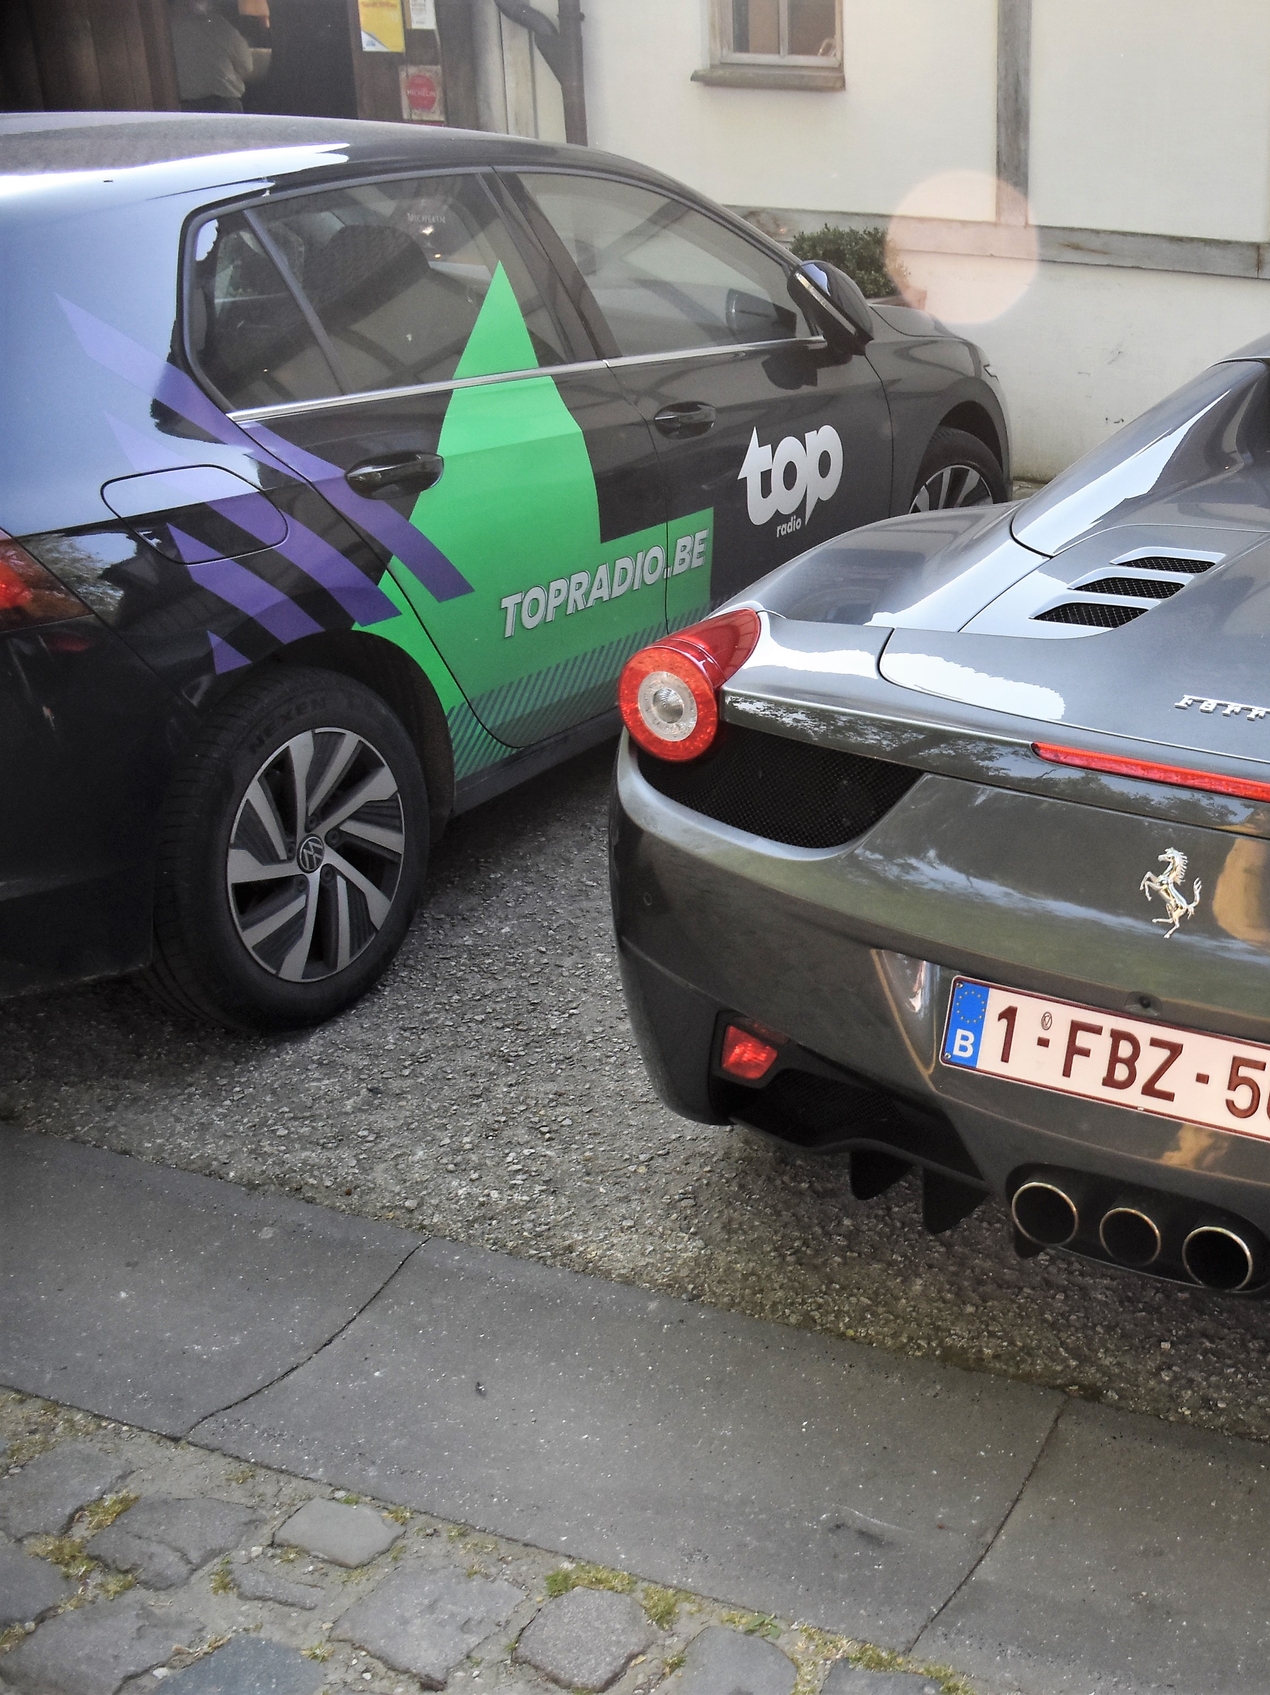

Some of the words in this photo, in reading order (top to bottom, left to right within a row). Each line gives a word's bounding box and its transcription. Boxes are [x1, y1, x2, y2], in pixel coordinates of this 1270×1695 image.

[737, 424, 843, 526] top
[776, 515, 802, 538] radio
[500, 528, 710, 638] TOPRADIO.BE
[953, 1028, 975, 1058] B
